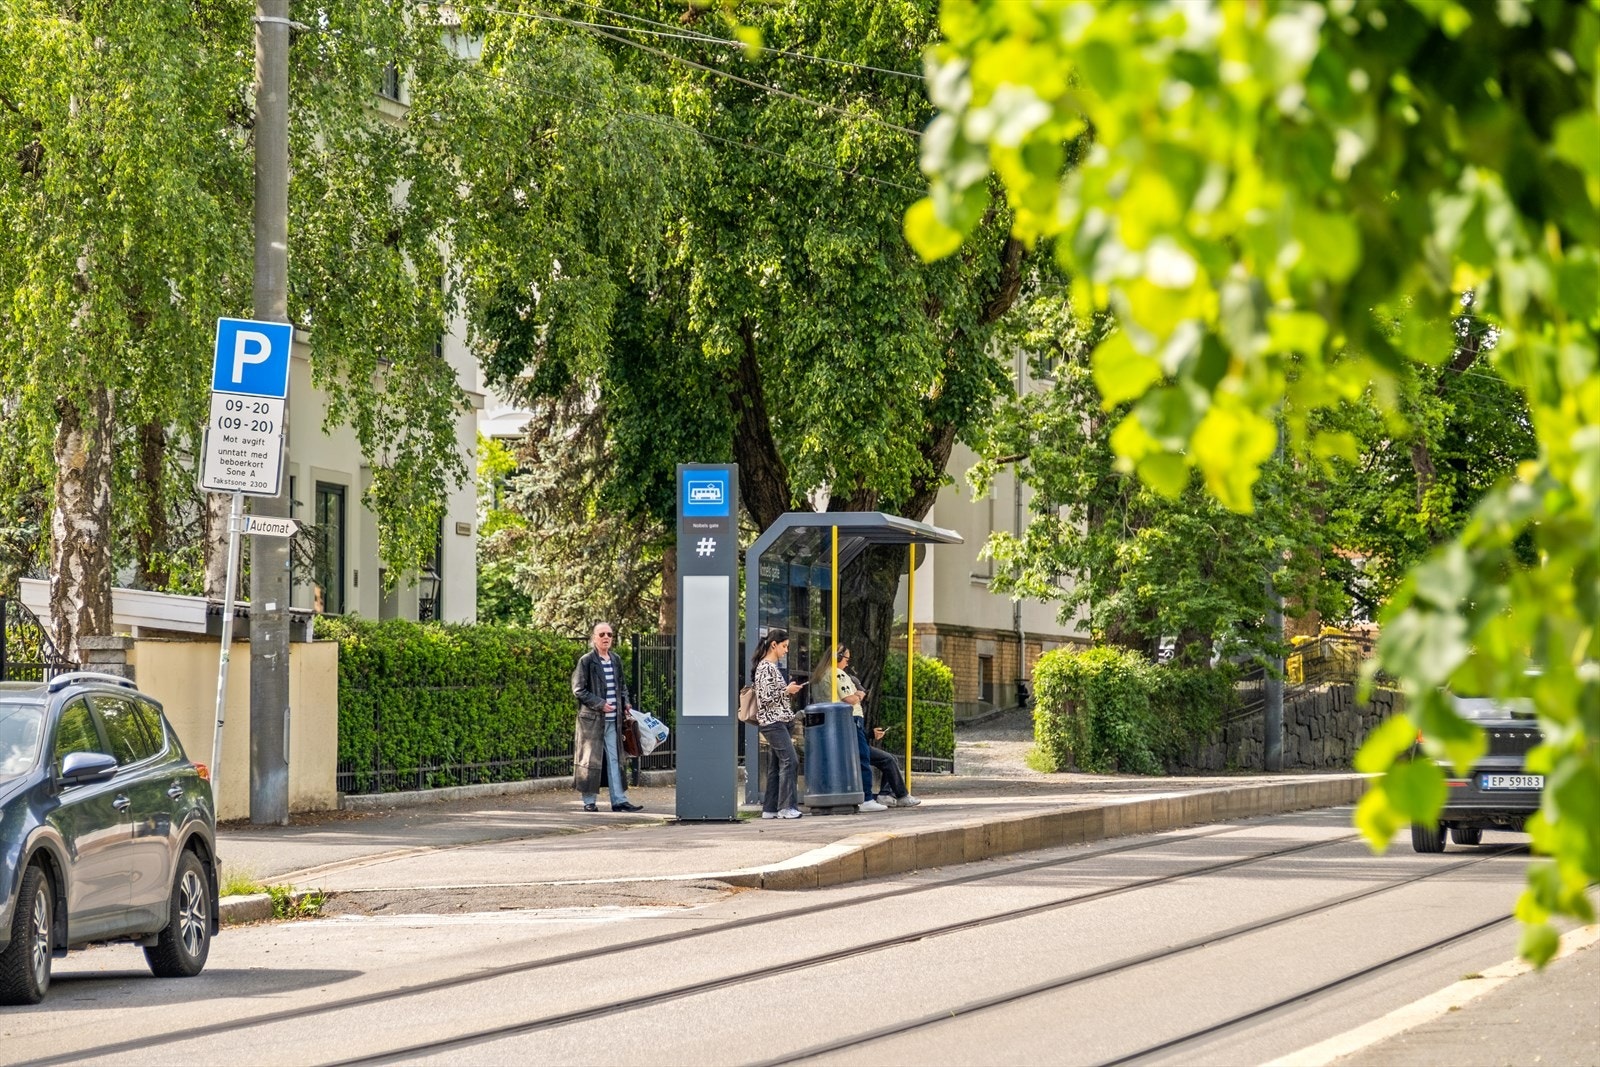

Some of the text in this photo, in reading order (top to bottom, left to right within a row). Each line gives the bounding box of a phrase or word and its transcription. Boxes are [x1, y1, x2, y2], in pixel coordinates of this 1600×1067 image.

[231, 329, 272, 384] P
[225, 399, 270, 415] 09-20
[222, 434, 265, 446] Mot avgift
[218, 449, 247, 457] unntatt
[219, 457, 264, 468] beboerkort
[226, 467, 246, 476] Sone
[213, 477, 268, 489] Takstsone 2300
[250, 519, 290, 534] Automat
[1492, 777, 1540, 787] EP 59183
